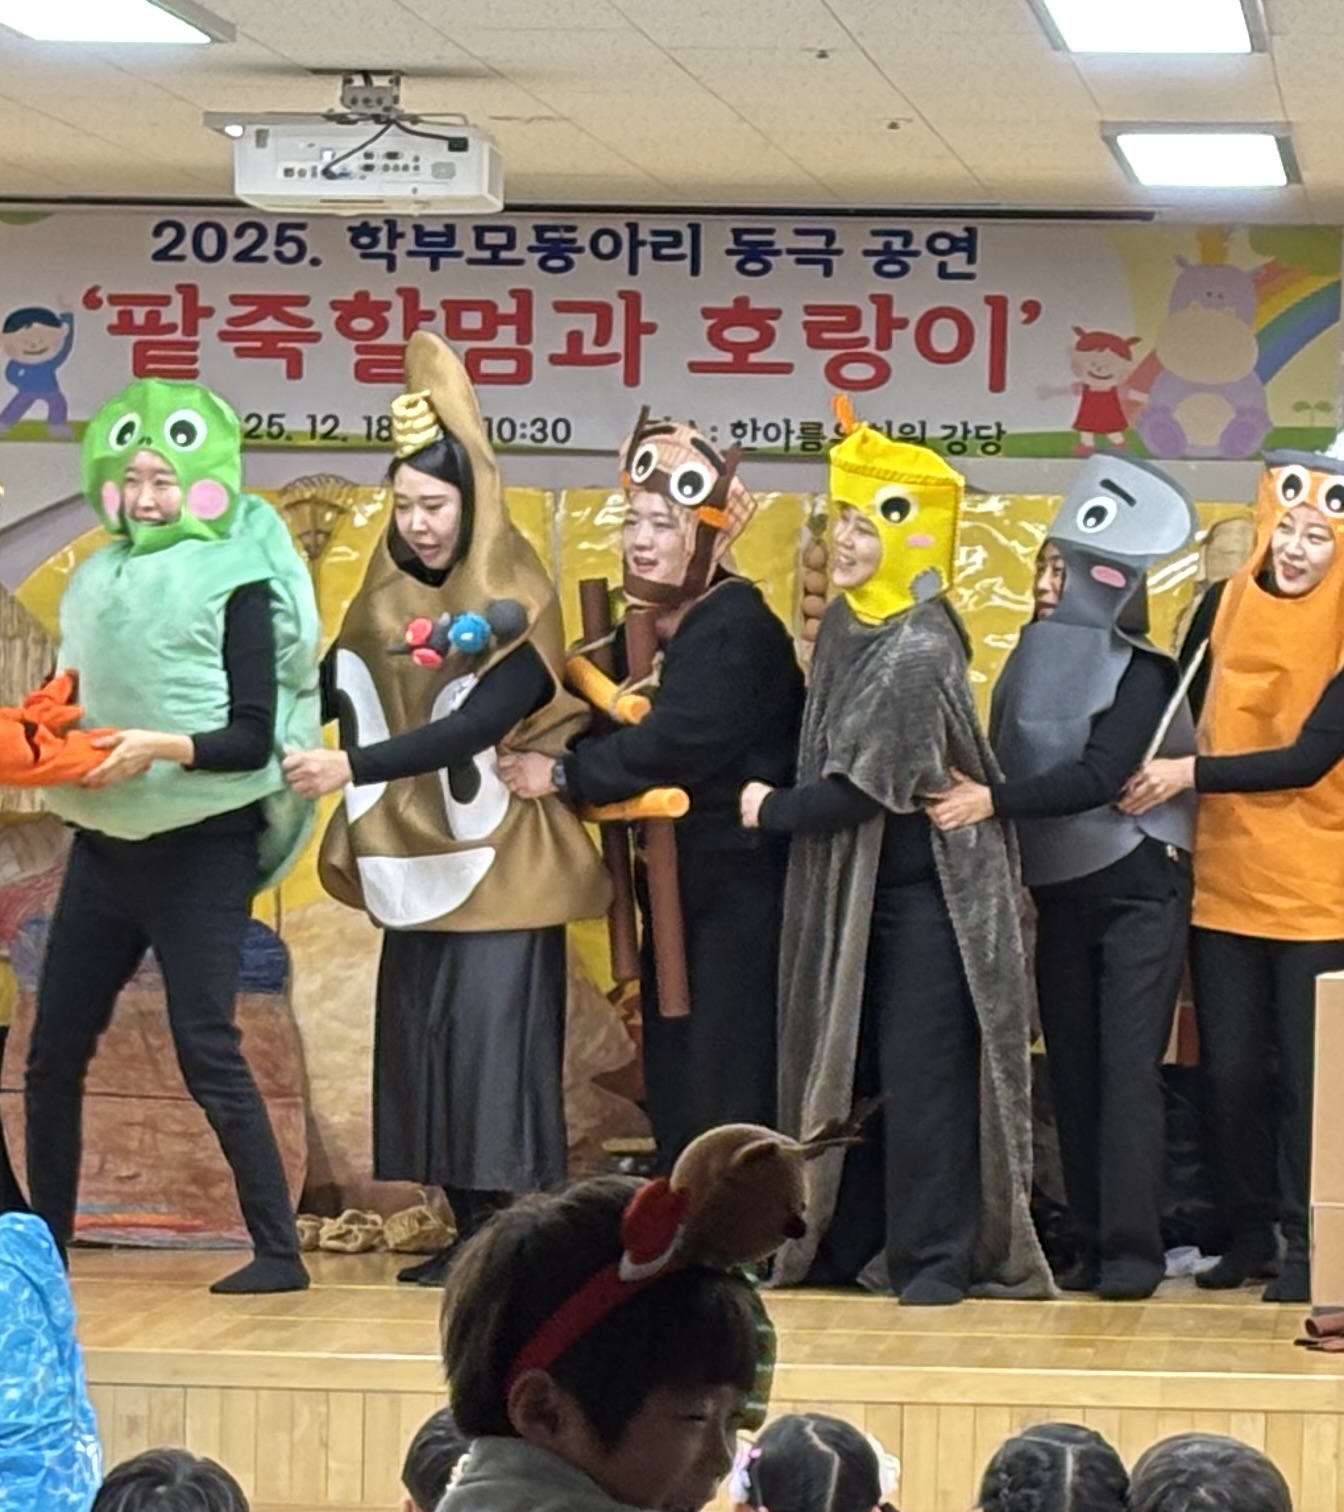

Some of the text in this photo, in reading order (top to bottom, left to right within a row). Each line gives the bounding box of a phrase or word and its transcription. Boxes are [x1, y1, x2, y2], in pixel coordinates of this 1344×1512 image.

[151, 219, 980, 281] 2025. 학부모동아리 동극 공연
[243, 413, 293, 440] 25.
[307, 414, 348, 442] 12.
[483, 417, 572, 444] 10:30
[939, 422, 1006, 455] 강당
